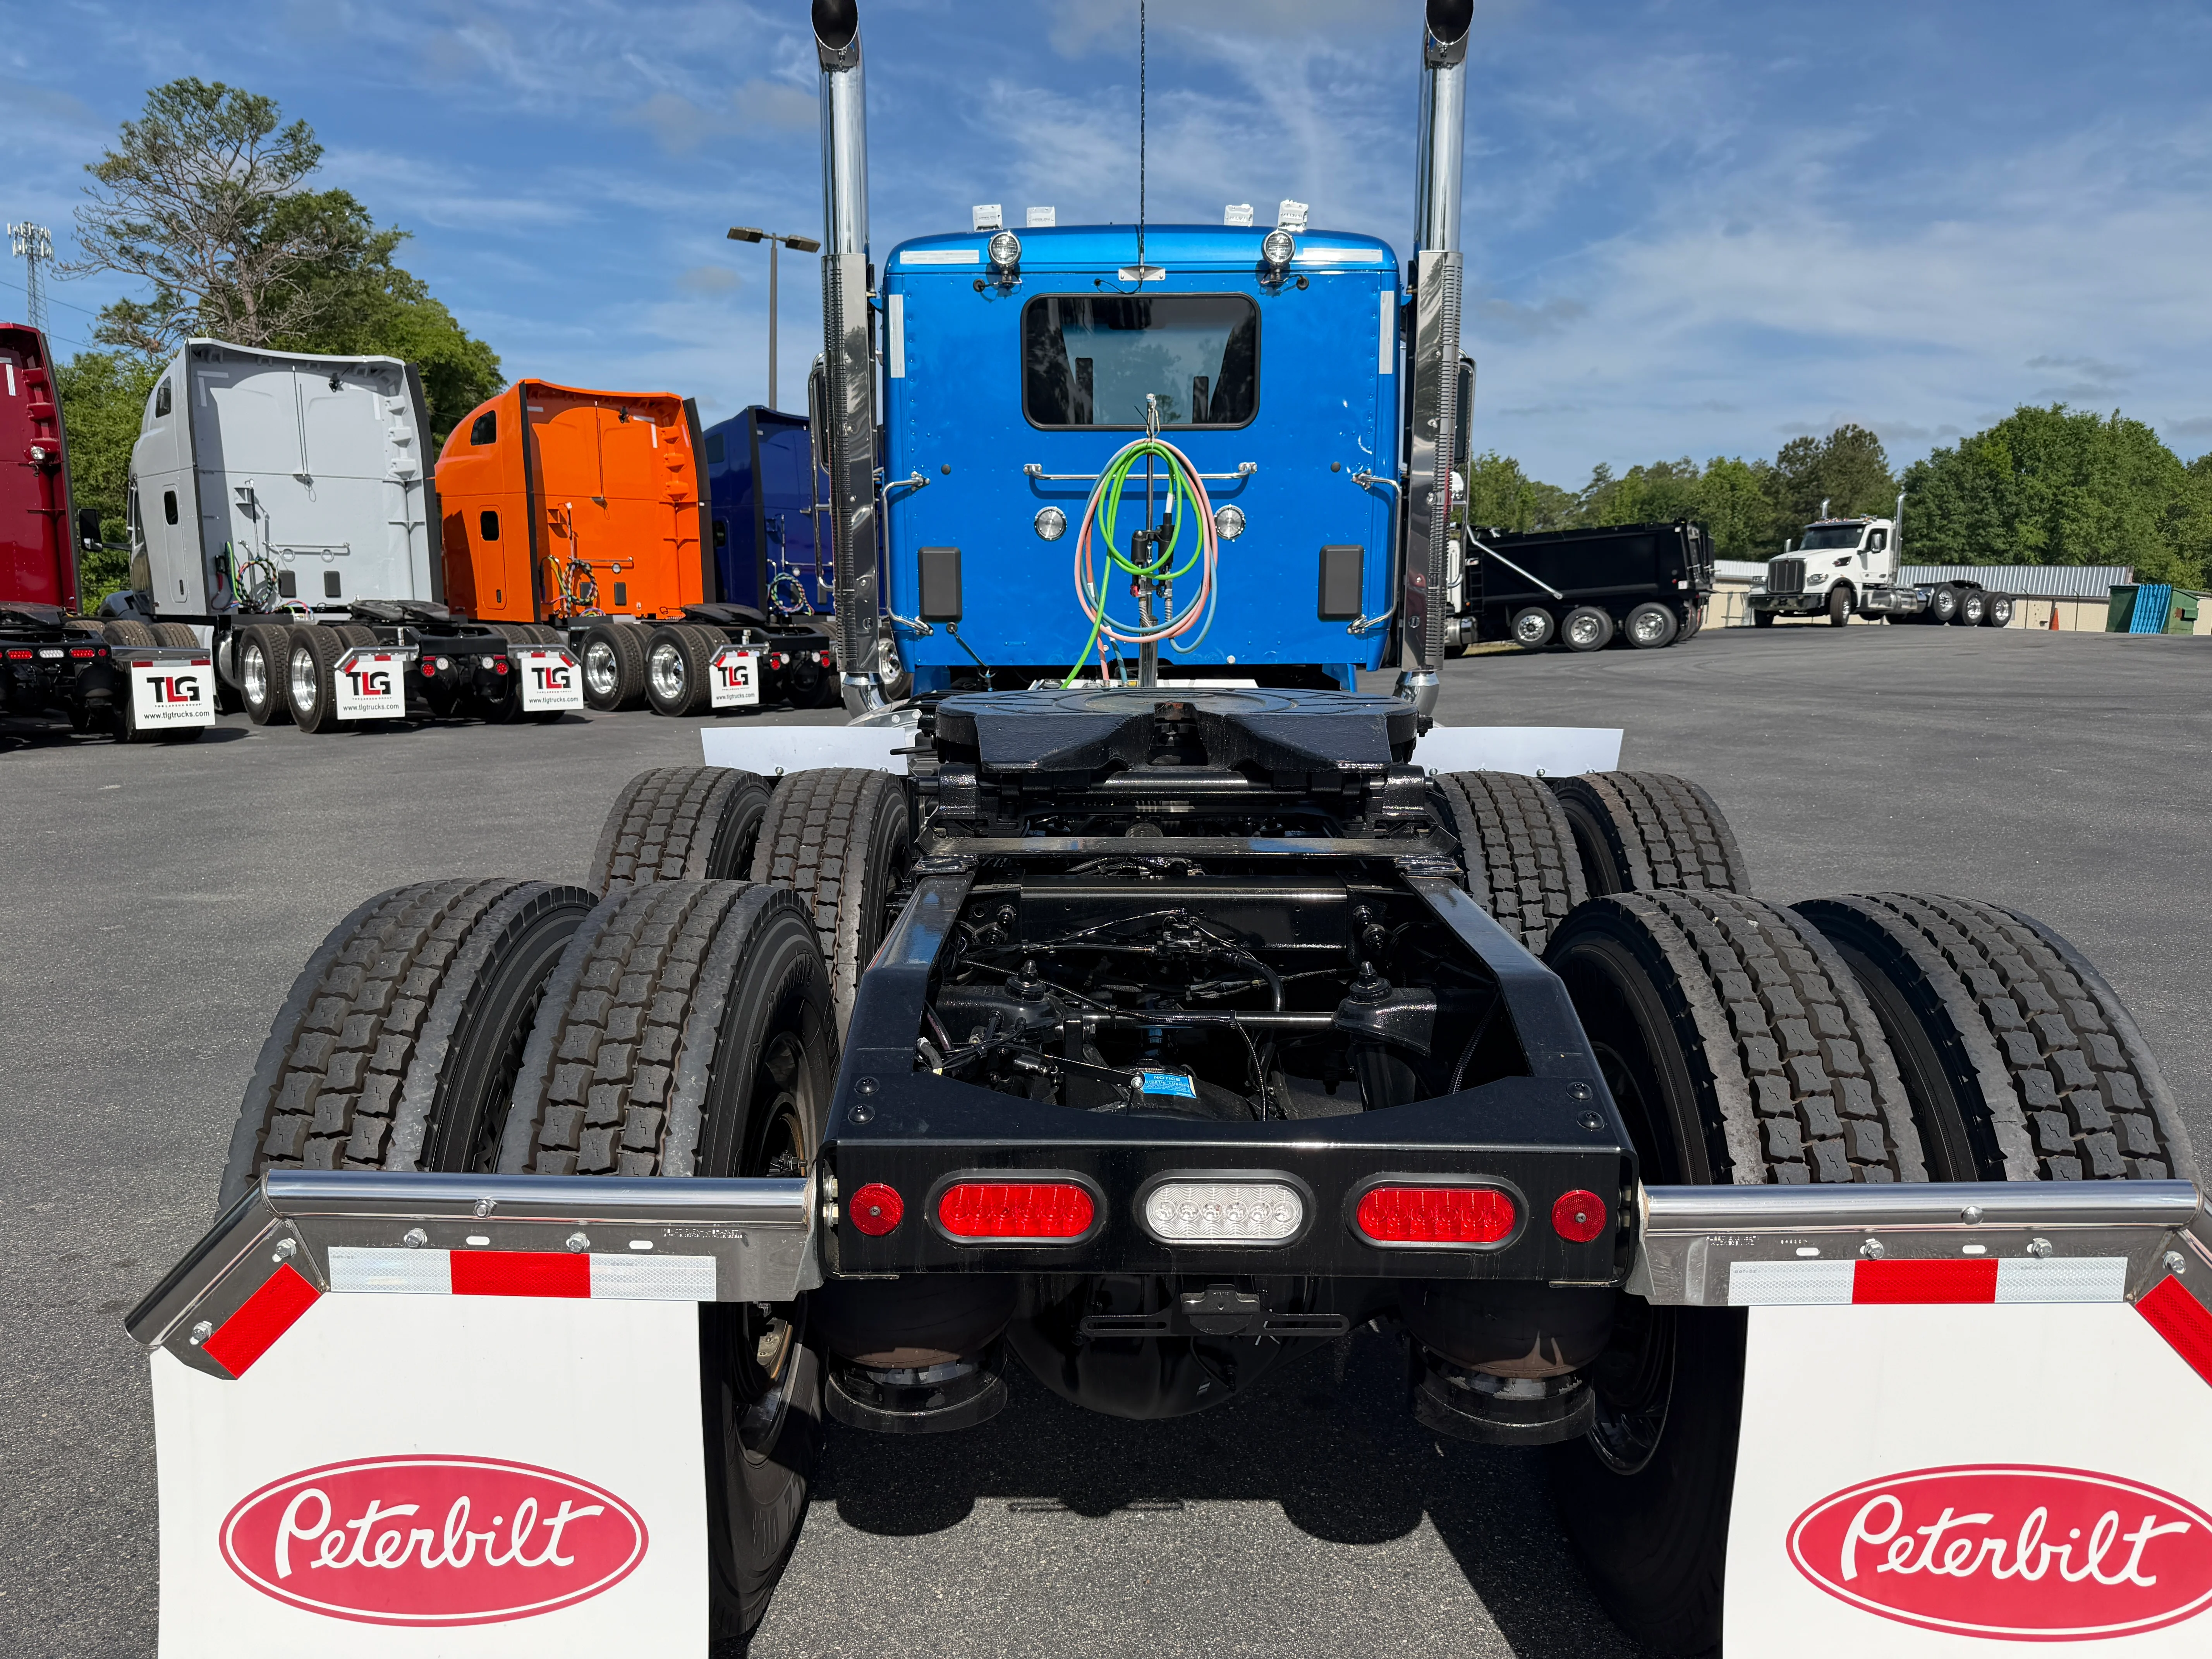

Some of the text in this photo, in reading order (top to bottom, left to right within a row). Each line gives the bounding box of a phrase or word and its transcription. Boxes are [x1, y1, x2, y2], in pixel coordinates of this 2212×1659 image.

[346, 672, 391, 696] TLG
[531, 667, 571, 689] TLG
[718, 666, 749, 687] TLG
[146, 676, 200, 702] TLG
[144, 711, 210, 720] www.tlgtrucks.com
[343, 704, 399, 712] www.tlgtrucks.com
[275, 1488, 605, 1578] Peterbilt
[1841, 1494, 2191, 1587] Peterbilt
